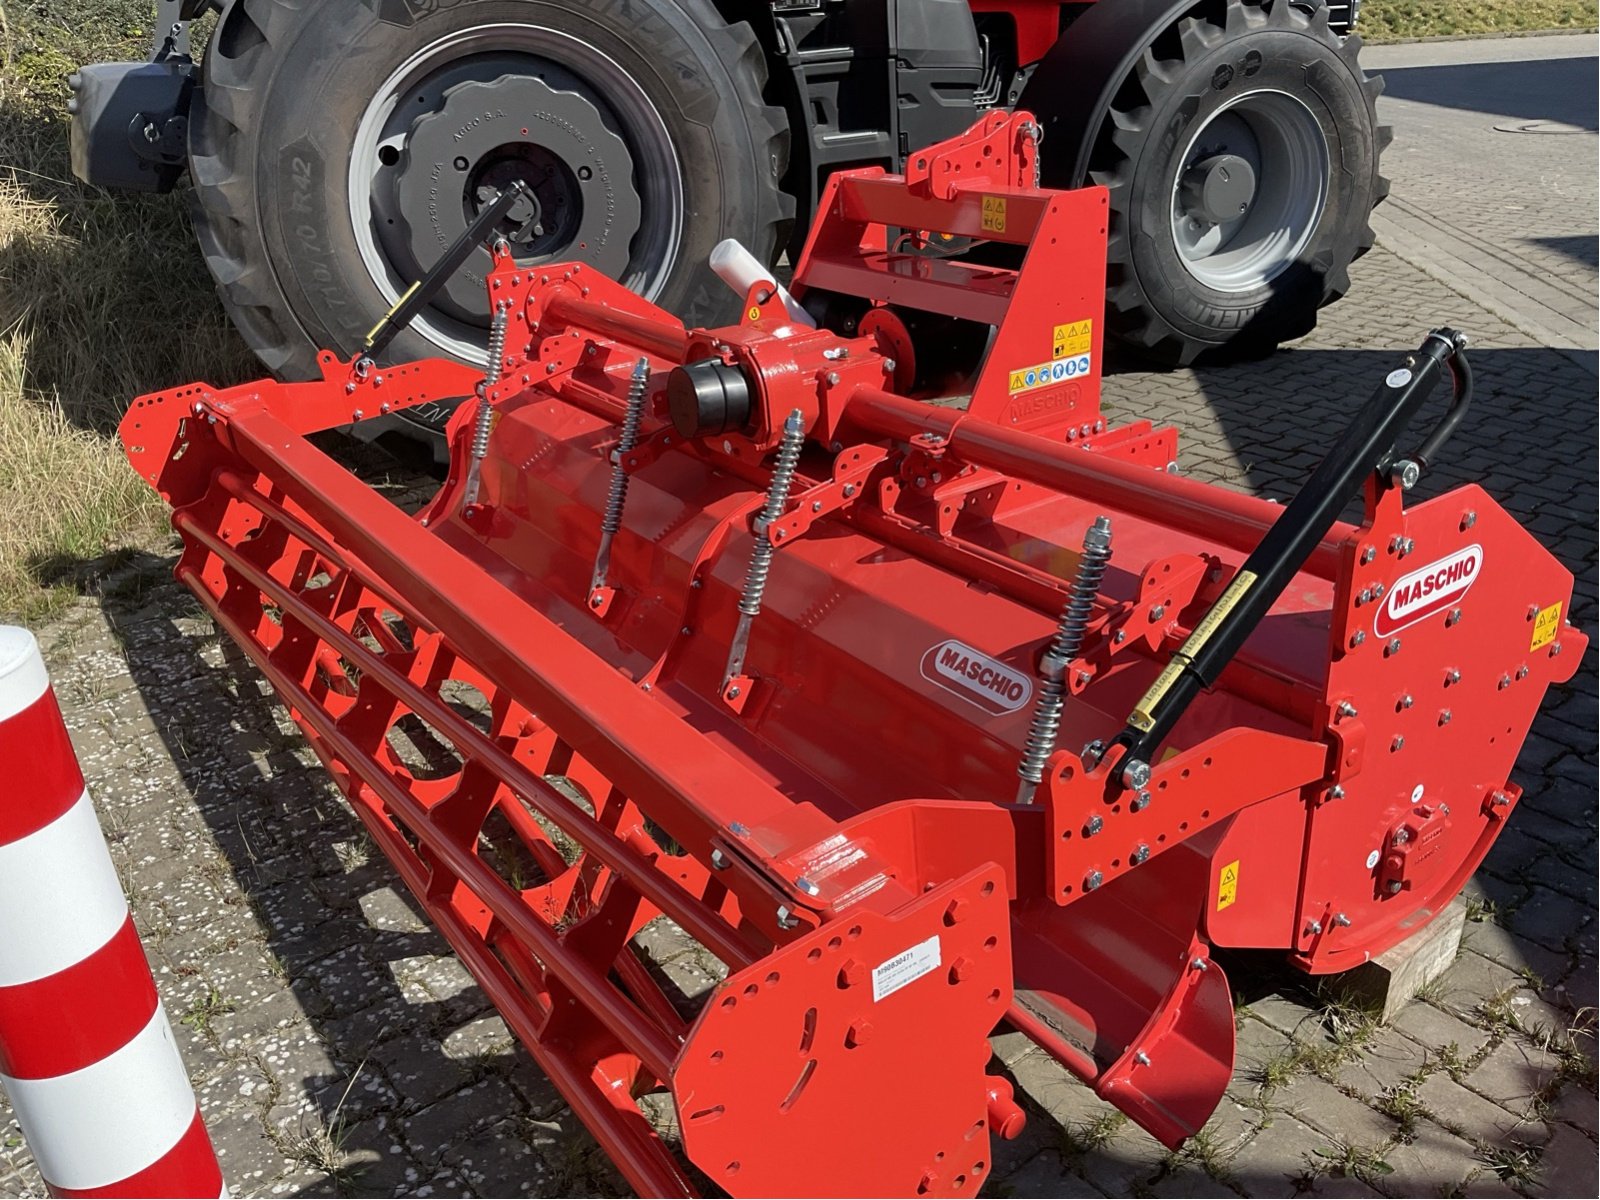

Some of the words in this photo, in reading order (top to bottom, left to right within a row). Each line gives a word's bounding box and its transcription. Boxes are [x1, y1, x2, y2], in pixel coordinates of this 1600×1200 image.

[1011, 389, 1079, 418] MASCHIO
[1393, 555, 1476, 611] MASCHIO
[940, 647, 1024, 701] MASCHIO
